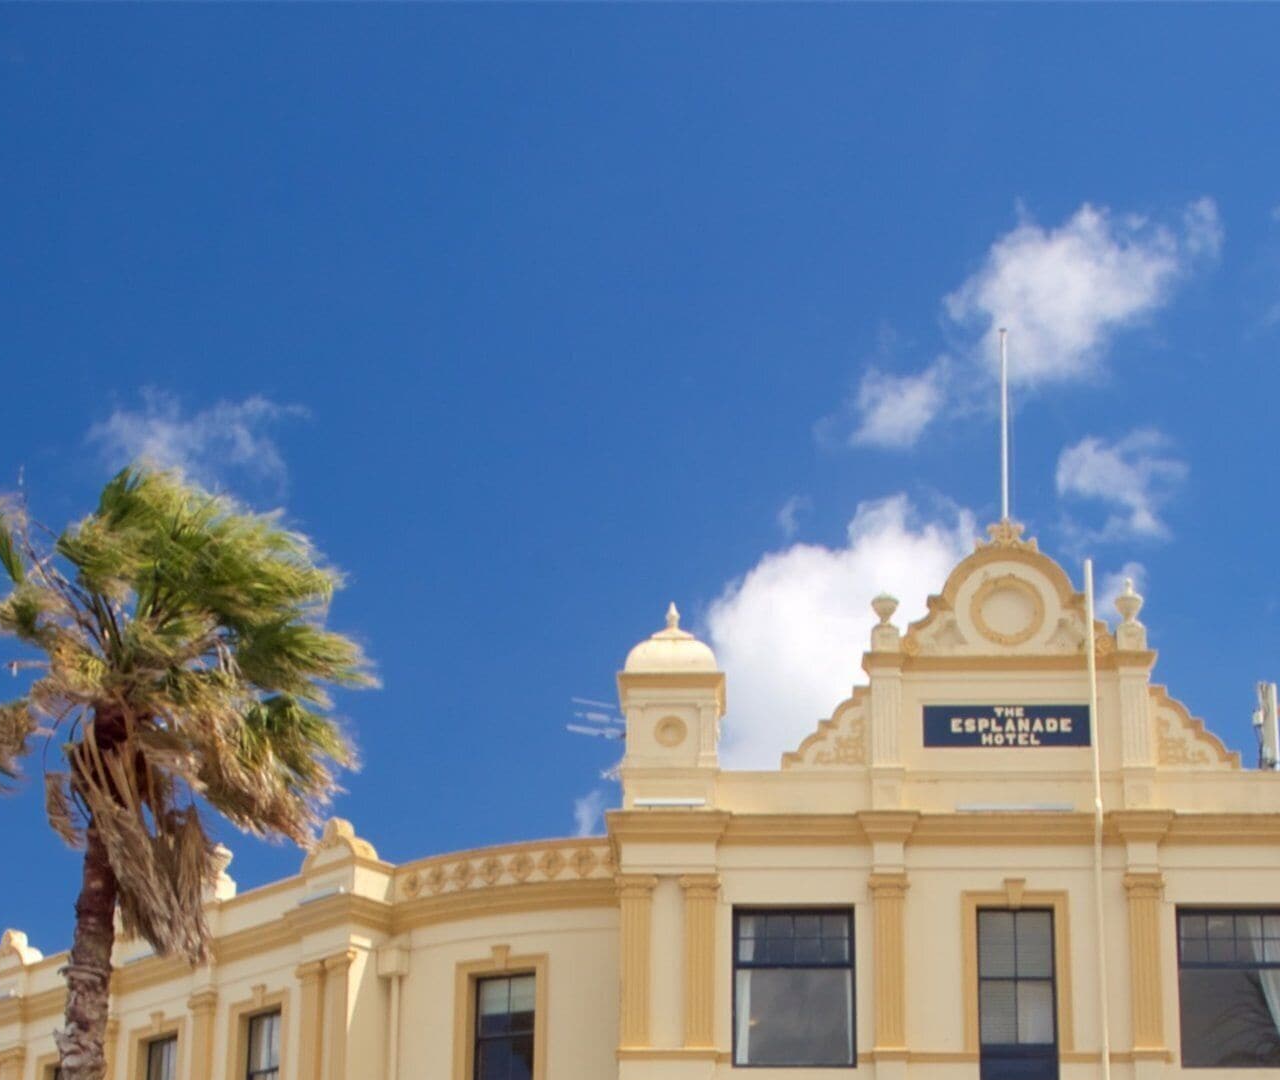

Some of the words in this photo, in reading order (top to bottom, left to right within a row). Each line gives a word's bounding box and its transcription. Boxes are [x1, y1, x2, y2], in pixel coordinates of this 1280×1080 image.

[994, 707, 1024, 717] THE
[950, 718, 1072, 733] ESPLANADE
[982, 733, 1040, 746] HOTEL
